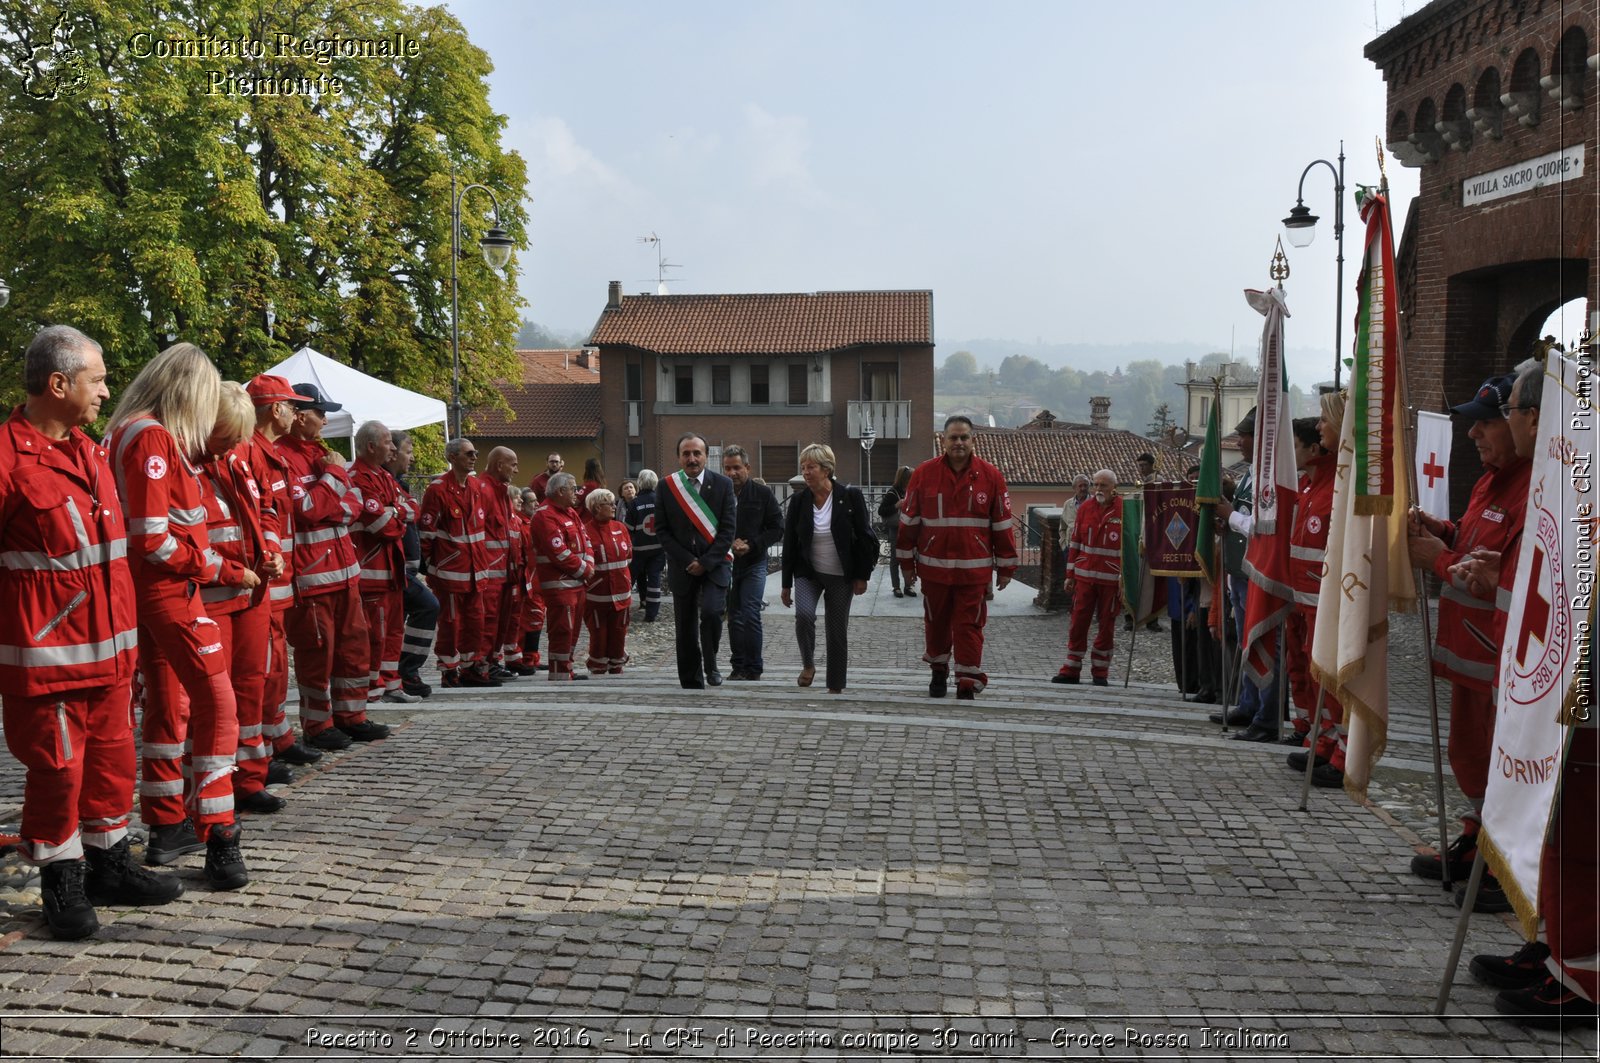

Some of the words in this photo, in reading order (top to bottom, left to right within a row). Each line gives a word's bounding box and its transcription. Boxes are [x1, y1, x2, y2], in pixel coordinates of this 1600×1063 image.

[1472, 178, 1499, 197] VILLA
[1502, 168, 1533, 189] SACRO
[1536, 156, 1571, 180] CUORE
[1367, 263, 1386, 316] CHIERI
[1368, 319, 1386, 334] DI
[1365, 337, 1386, 401] LOCALE
[1365, 407, 1386, 488] COMITATO
[1162, 553, 1193, 562] PECETTO
[1551, 552, 1561, 577] 22
[1548, 581, 1568, 666] AGOSTO
[1531, 663, 1554, 694] 1864
